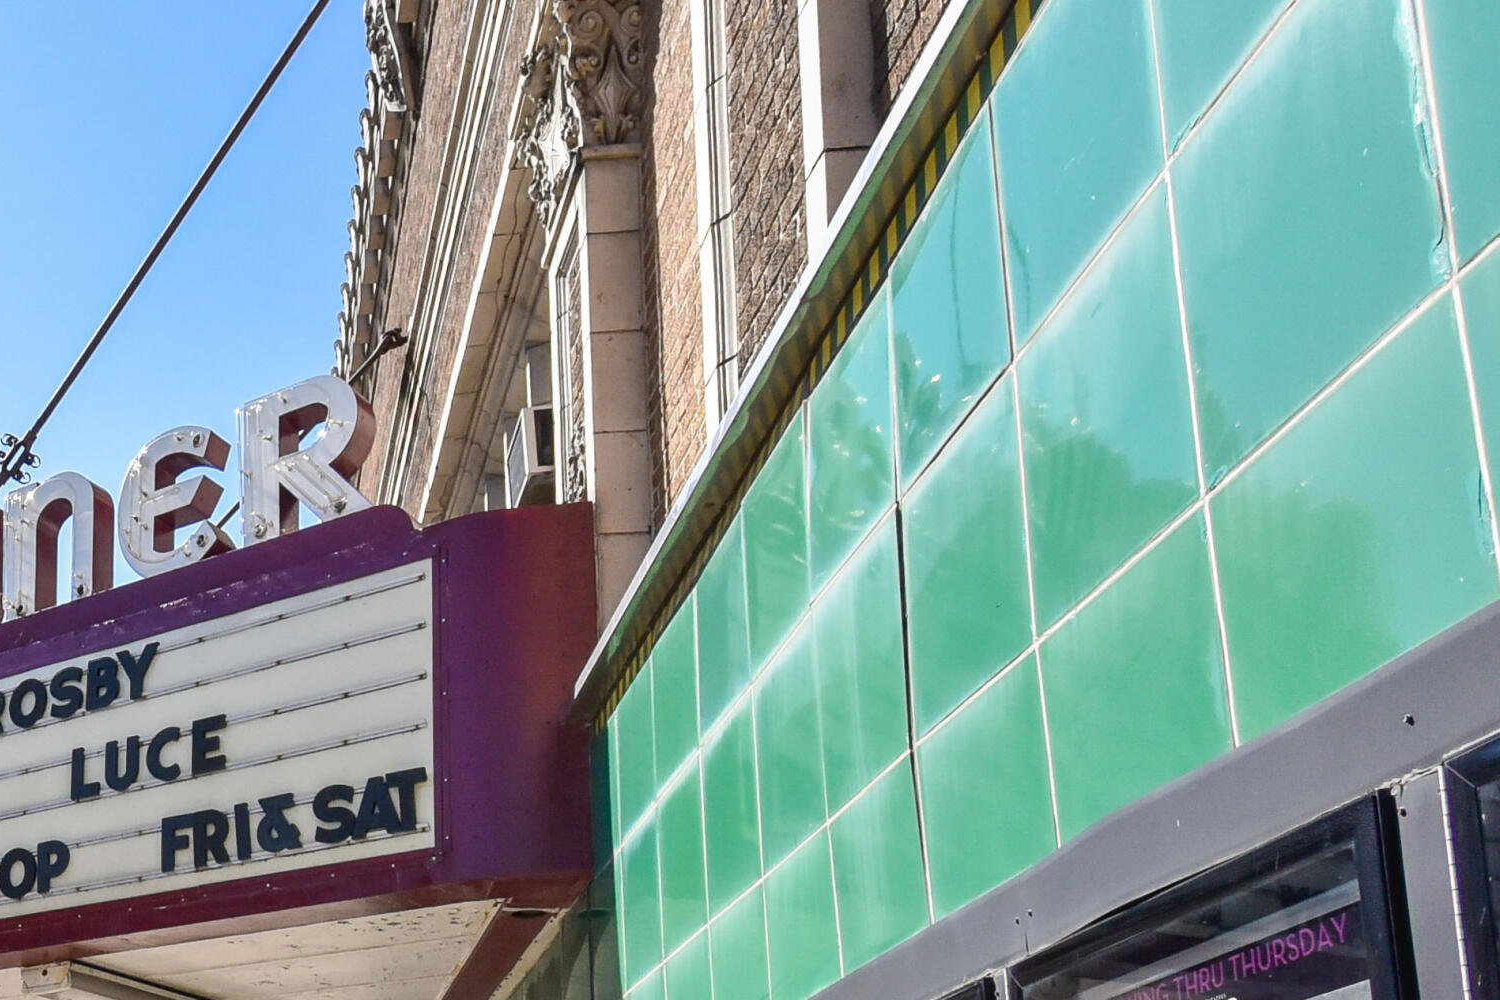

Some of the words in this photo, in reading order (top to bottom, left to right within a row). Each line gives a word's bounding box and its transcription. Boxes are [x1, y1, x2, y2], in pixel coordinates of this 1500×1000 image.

[70, 713, 228, 802] LUCE
[1173, 962, 1225, 1000] THRU
[1228, 912, 1347, 981] THURSDAY
